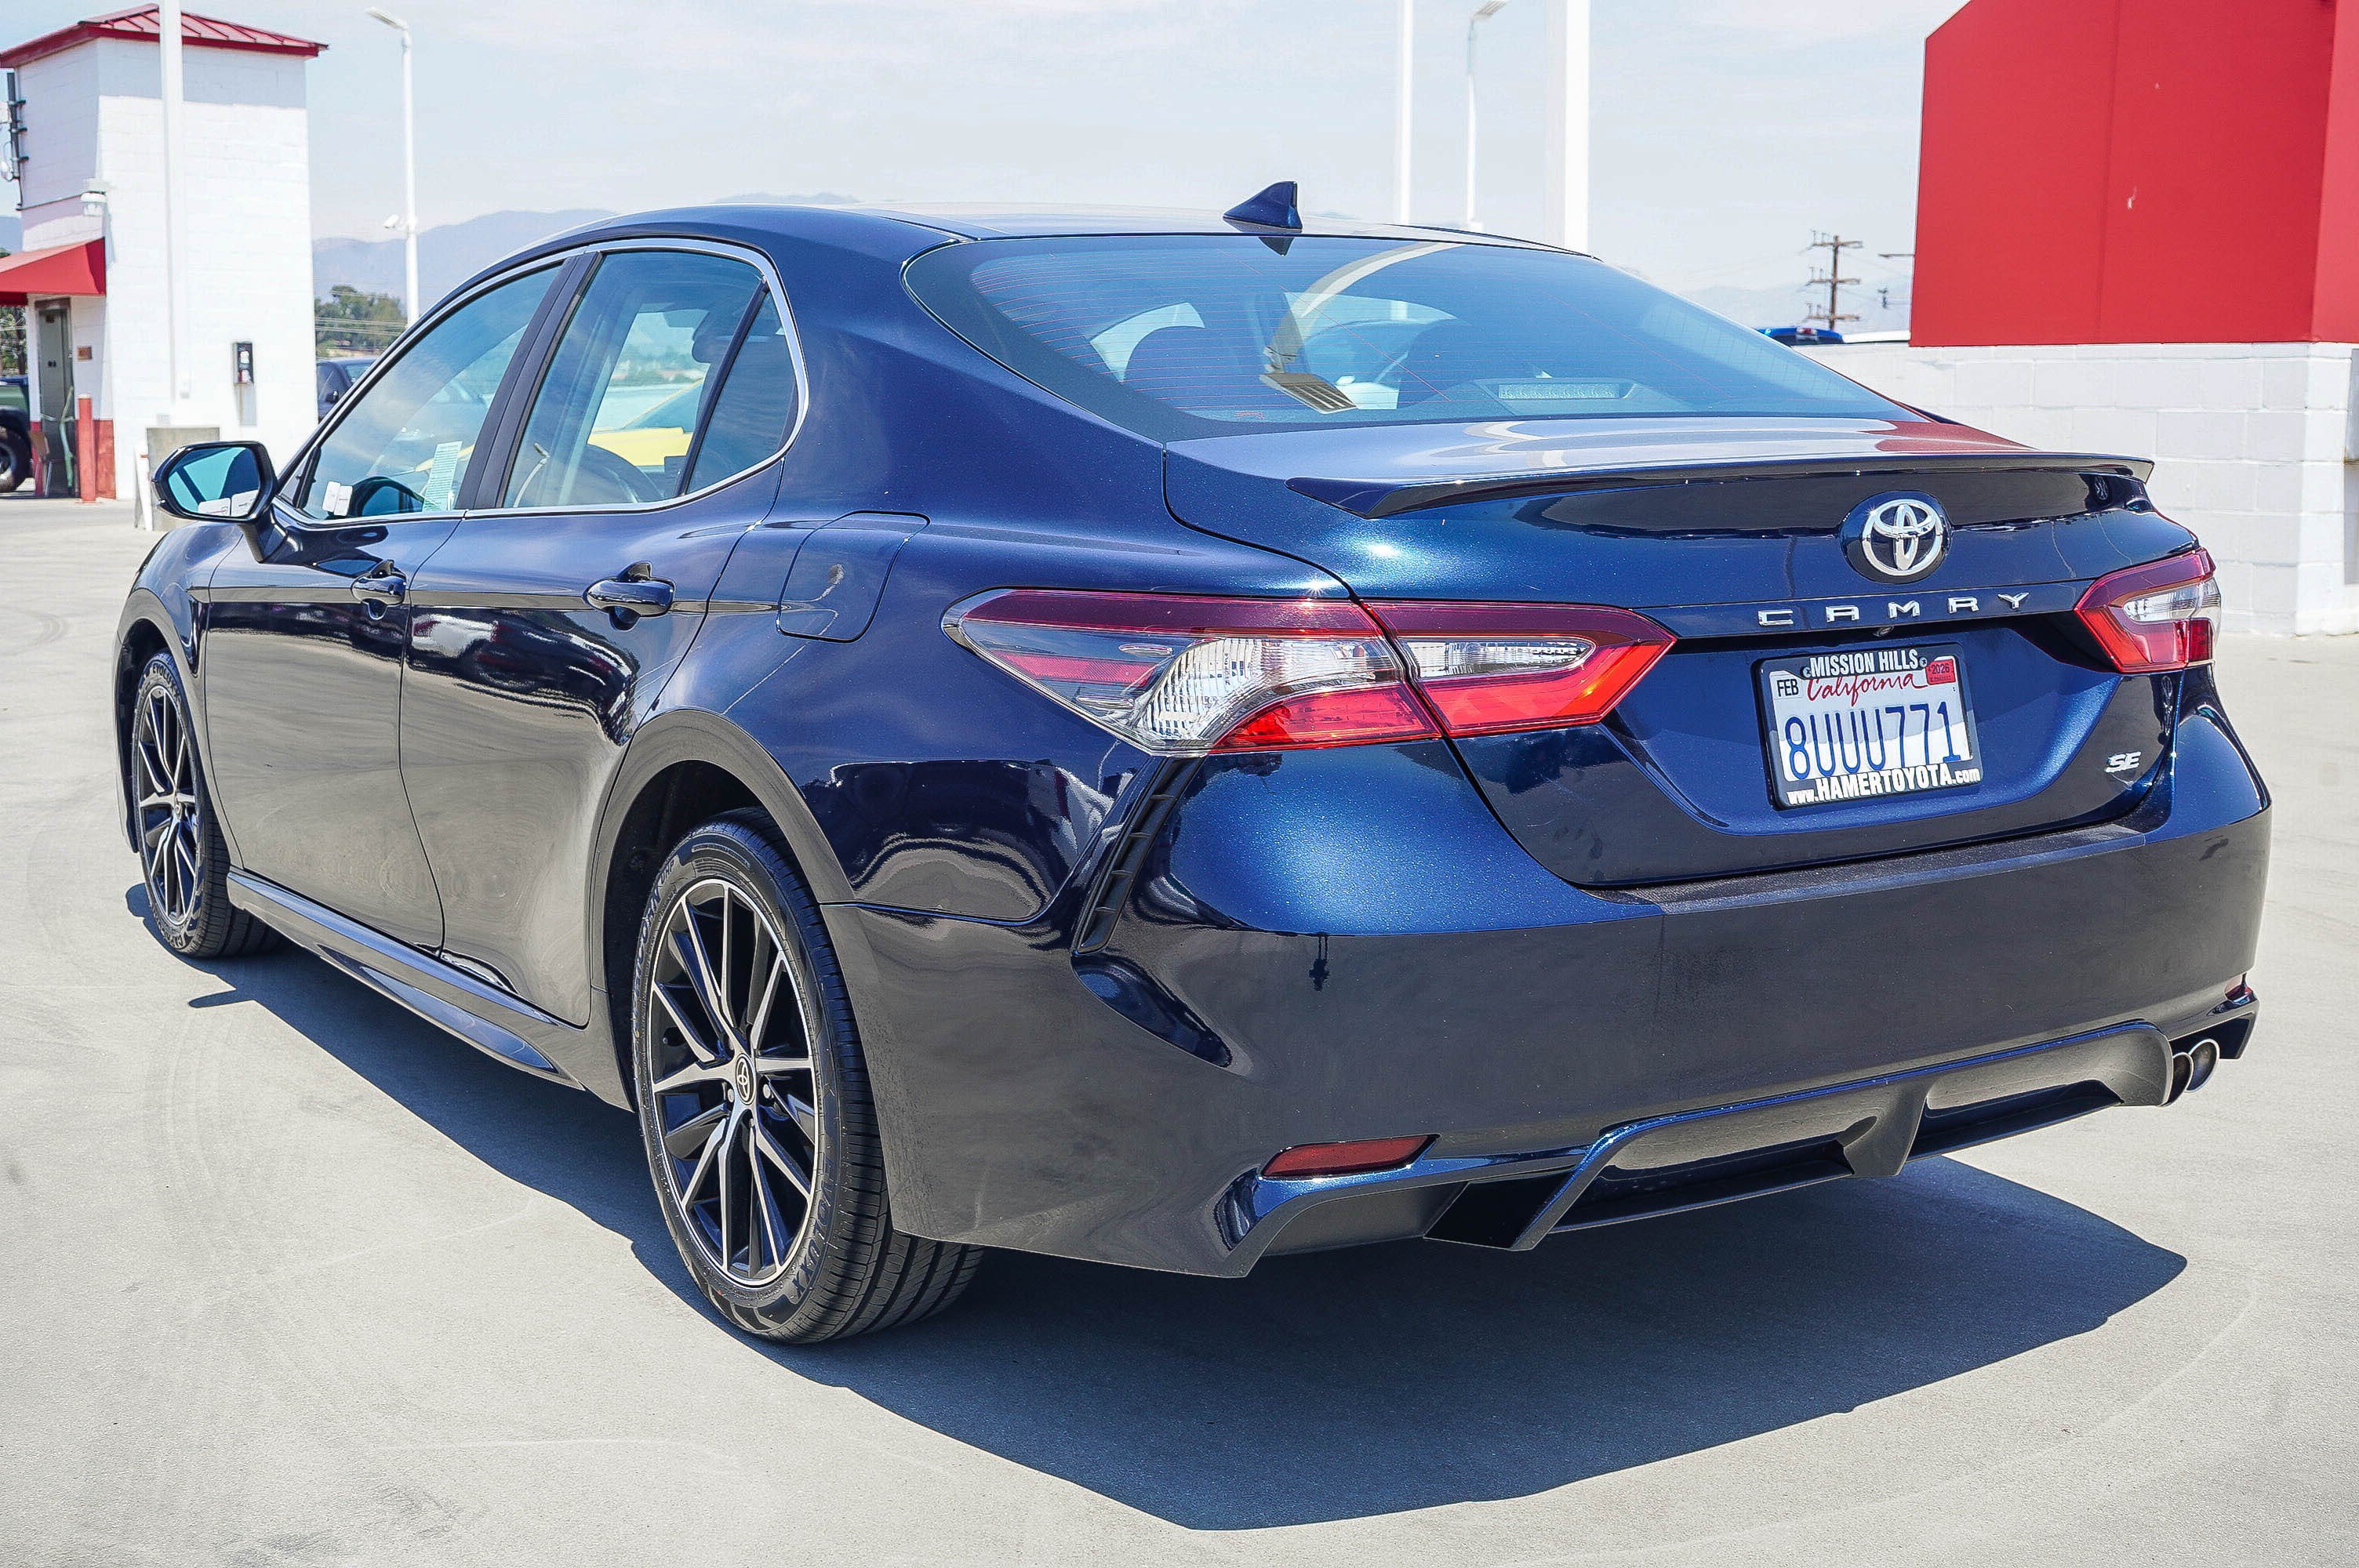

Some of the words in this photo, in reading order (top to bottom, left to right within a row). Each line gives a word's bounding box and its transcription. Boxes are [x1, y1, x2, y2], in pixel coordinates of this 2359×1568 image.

[1758, 592, 2029, 626] CAMRY
[1809, 653, 1875, 677] MISSION
[1878, 648, 1918, 671] HILLS
[1932, 662, 1950, 675] 2026
[1776, 678, 1799, 697] FEB
[1806, 672, 1928, 706] California
[1784, 702, 1961, 779] 8UUU771
[2105, 751, 2141, 773] SE
[1786, 763, 1981, 805] www.HAMERTOYOTA.com
